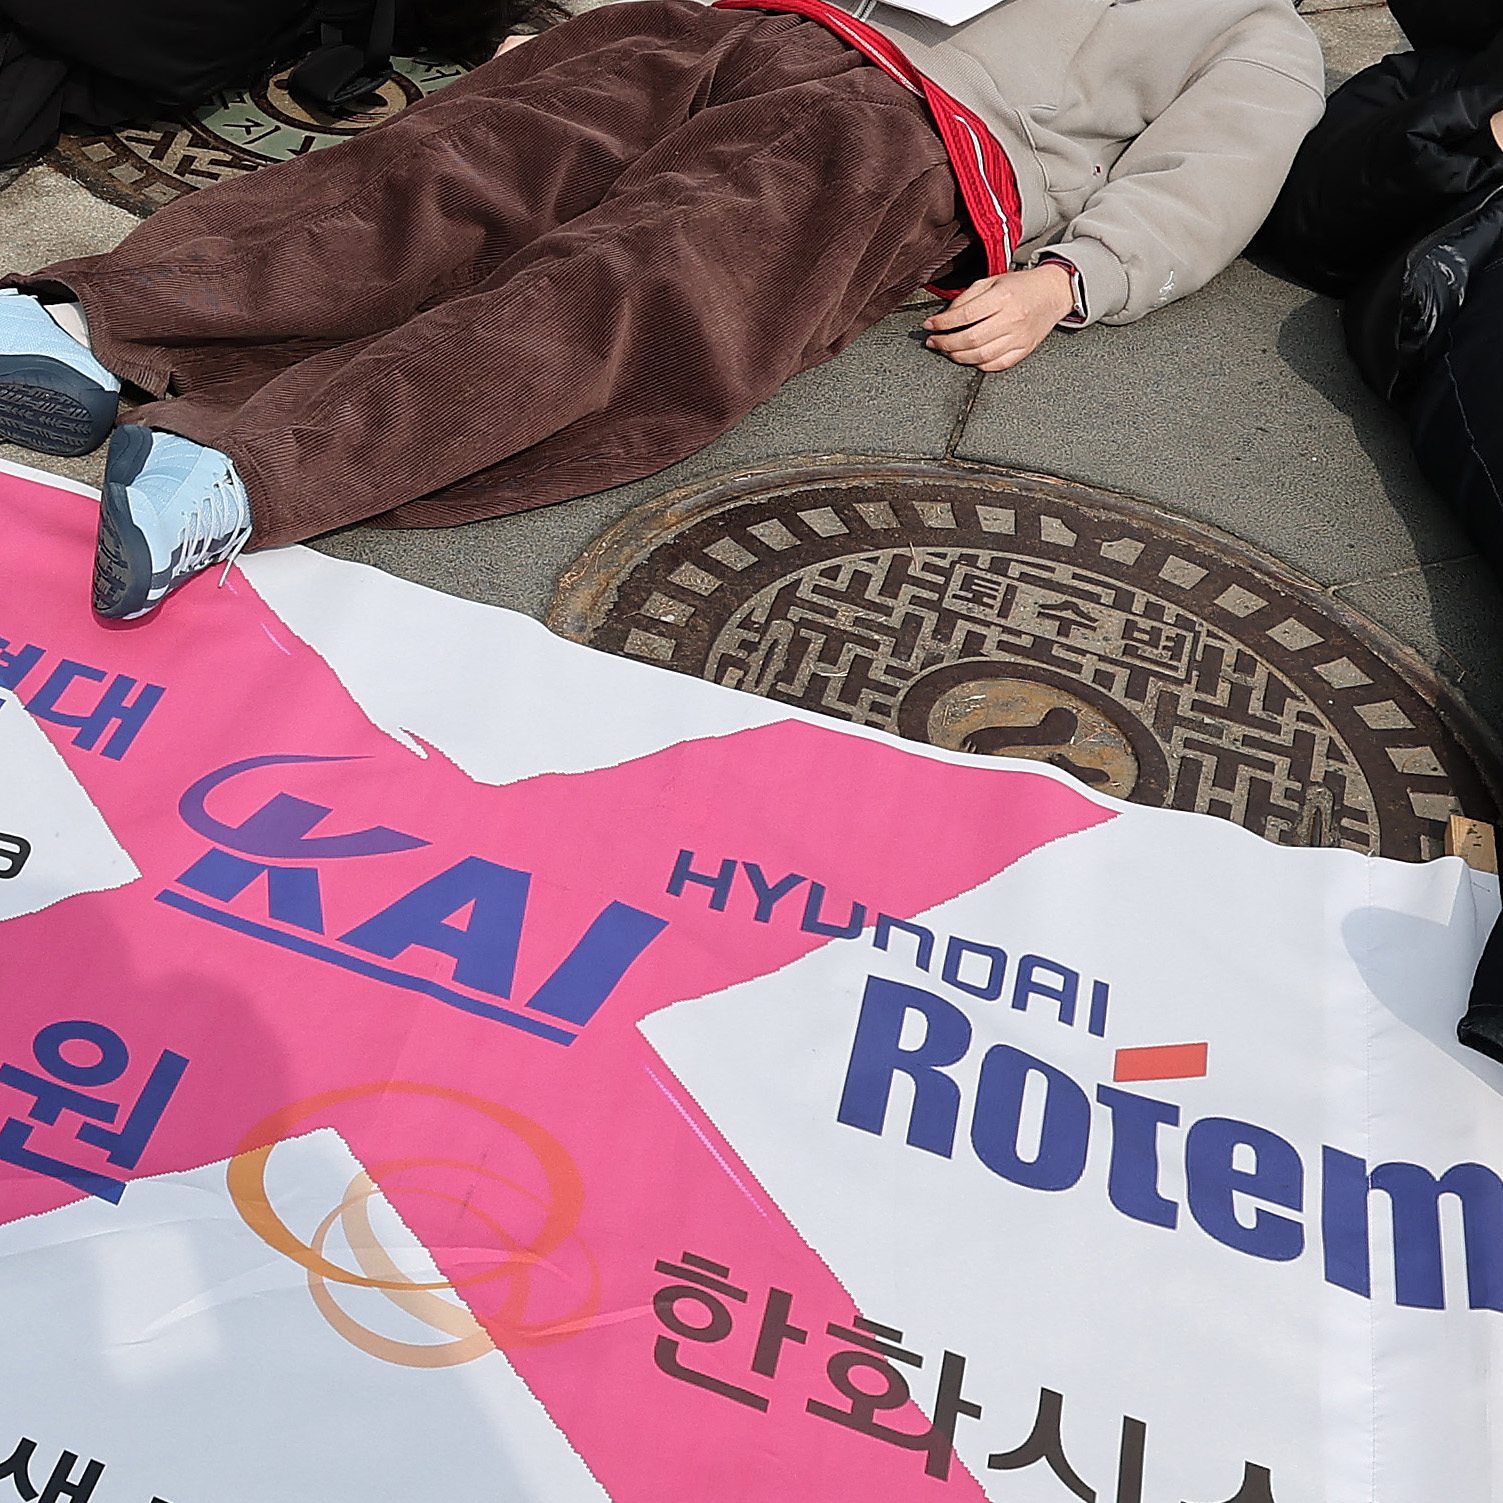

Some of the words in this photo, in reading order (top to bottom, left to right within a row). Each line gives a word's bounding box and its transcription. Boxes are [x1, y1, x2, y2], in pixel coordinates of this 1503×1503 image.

[176, 754, 670, 1028] KAI
[665, 848, 1109, 1037] HYUNDAI
[835, 974, 1503, 1313] Rotem
[651, 1250, 1278, 1503] 한화시
